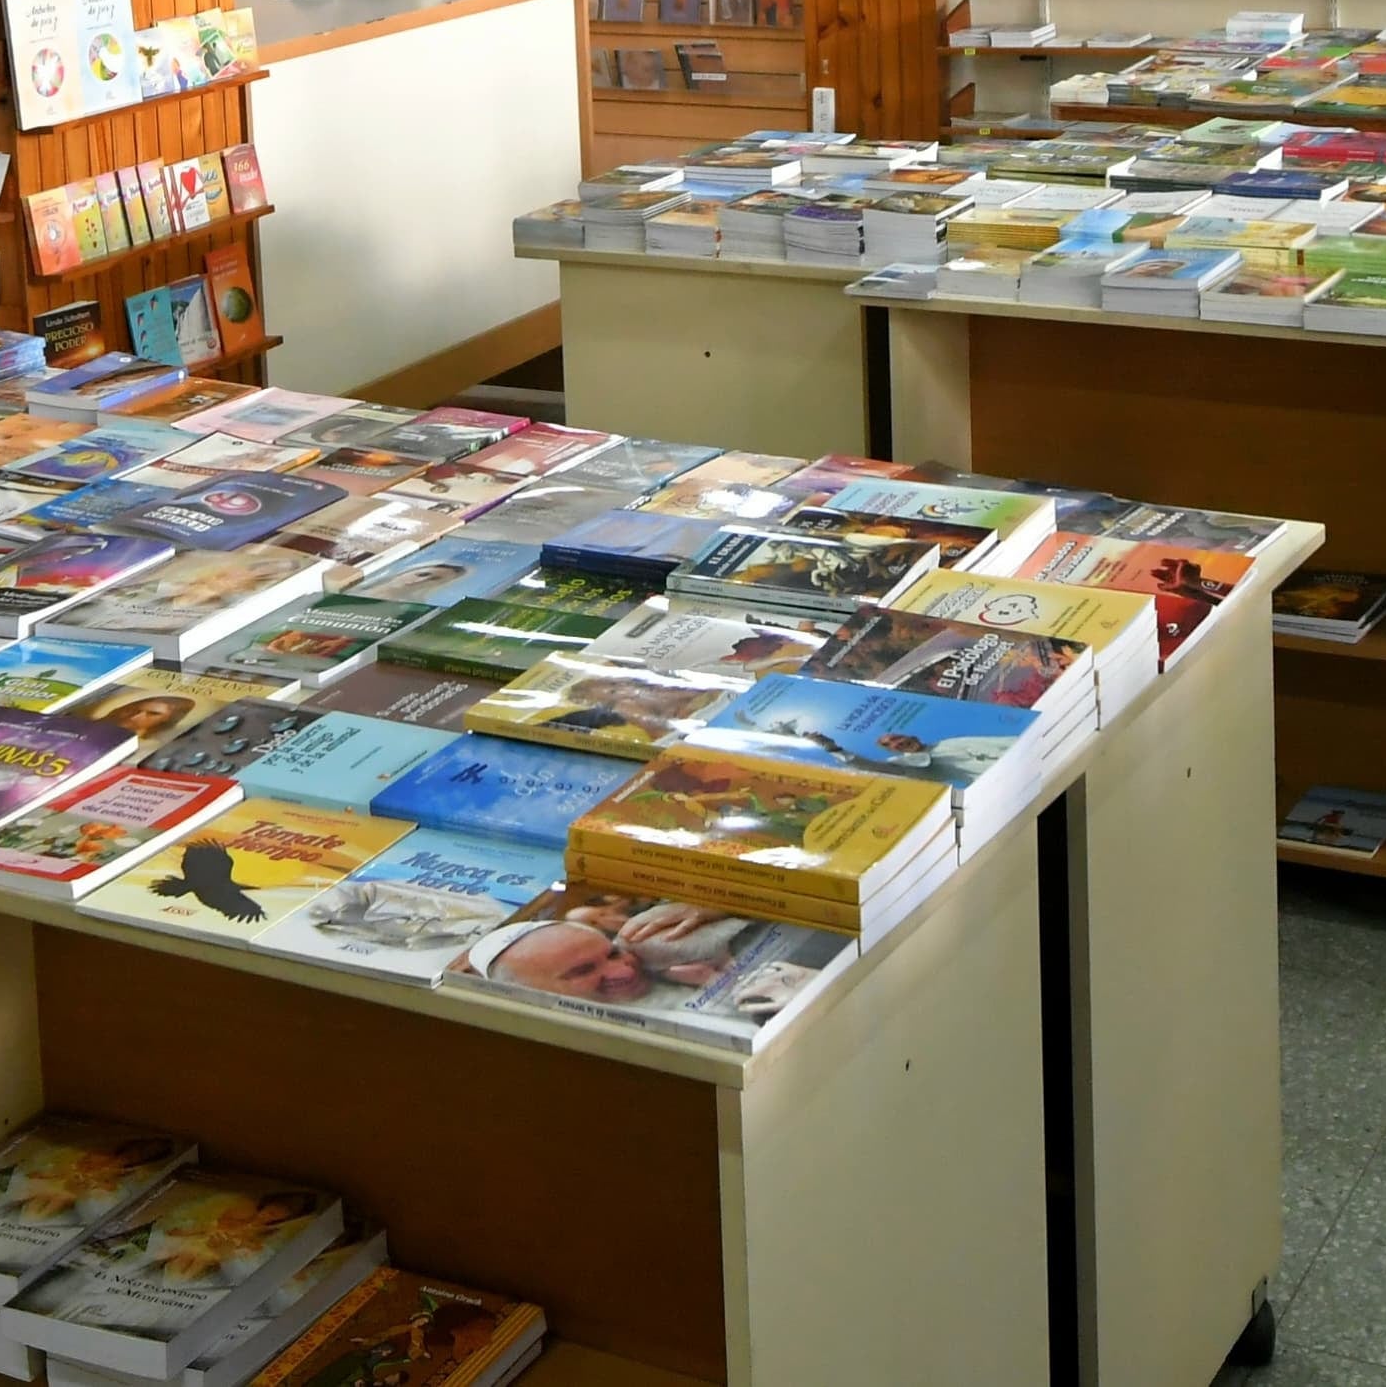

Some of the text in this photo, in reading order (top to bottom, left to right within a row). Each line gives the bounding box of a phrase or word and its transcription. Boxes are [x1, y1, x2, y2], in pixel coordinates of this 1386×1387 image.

[44, 322, 94, 344] PRECIOSO
[54, 336, 87, 353] PODER
[287, 611, 392, 635] Comunión
[937, 633, 1000, 690] El Psicólogo
[6, 676, 50, 691] Gran
[35, 757, 71, 777] 5
[241, 819, 347, 850] Tómate
[223, 837, 324, 863] tiempo
[401, 849, 535, 887] Nunca es
[406, 869, 491, 897] tarde
